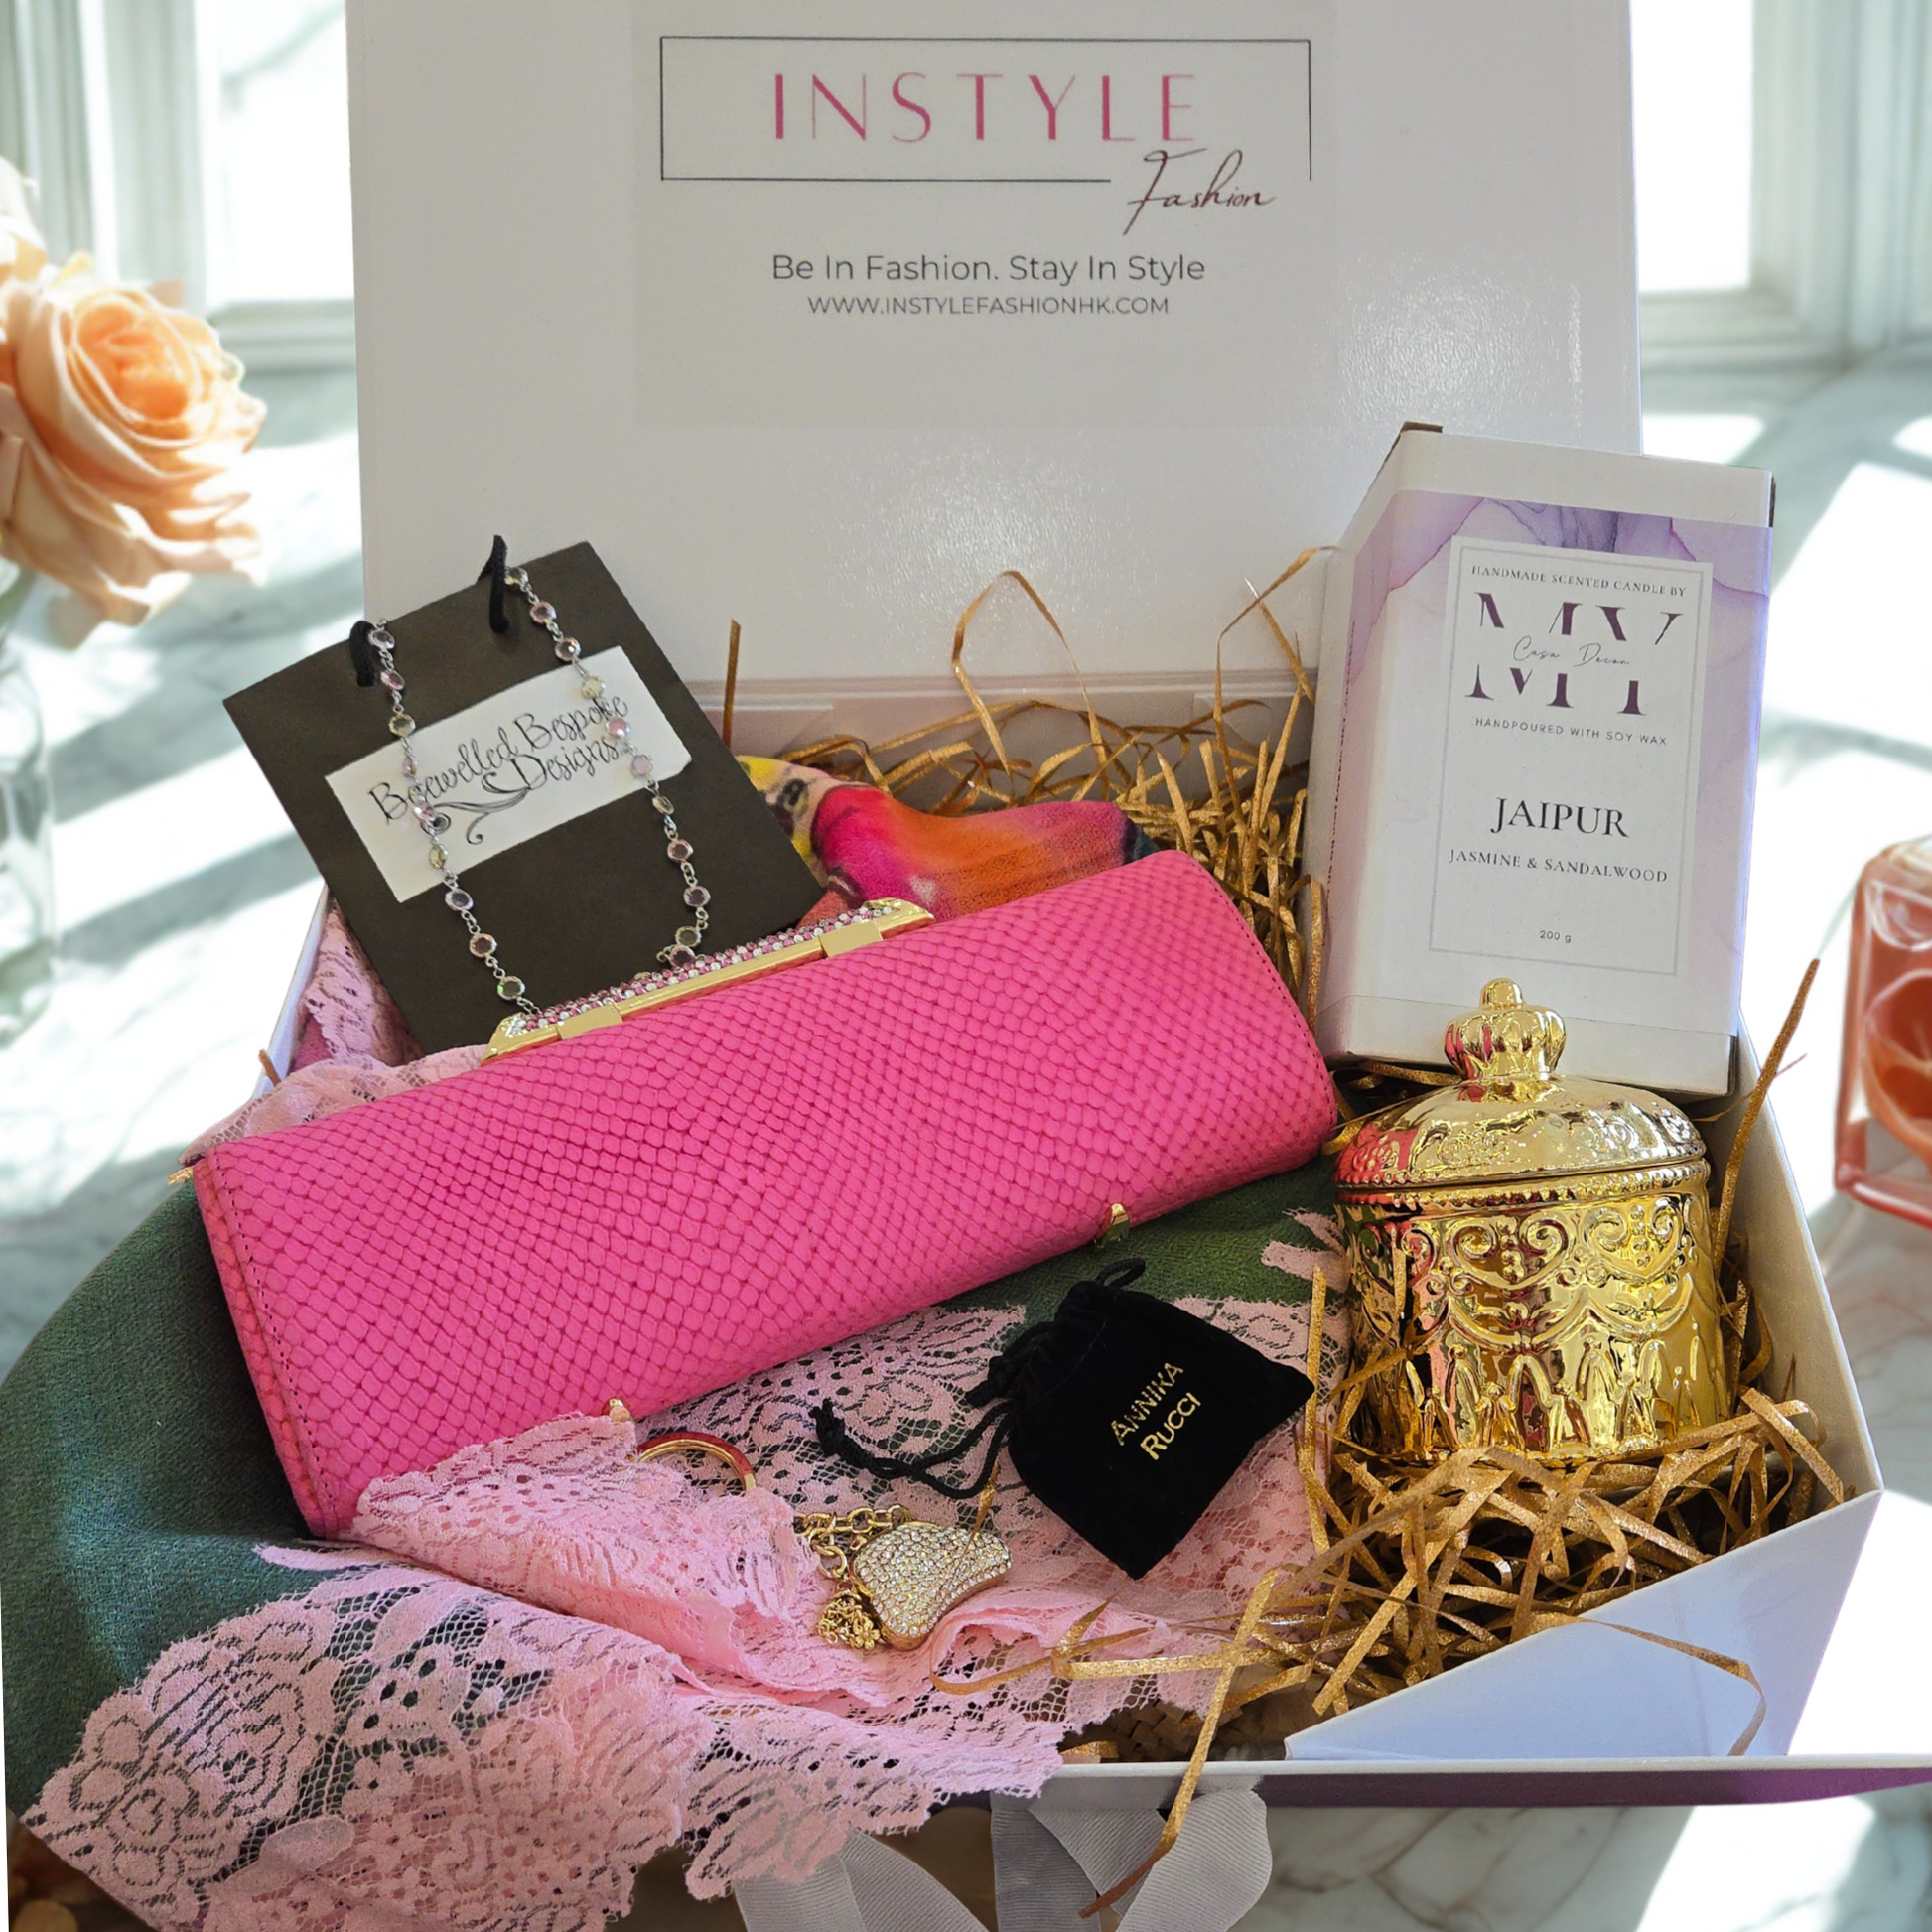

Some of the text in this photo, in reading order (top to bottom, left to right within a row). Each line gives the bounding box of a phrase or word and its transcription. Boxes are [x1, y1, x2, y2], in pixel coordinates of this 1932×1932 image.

[774, 71, 1196, 143] INSTYLE
[1123, 148, 1277, 237] Fashion
[772, 254, 1206, 287] Be In Fashion. Stay In Style
[807, 296, 1170, 316] WWW.INSTYLEFASHIONHK.COM
[1471, 565, 1687, 597] HANDMADE SCENTED CANDLE BY
[1512, 635, 1561, 662] Casa
[1475, 717, 1667, 747] HANDPOURED WITH SOY WAX
[484, 736, 620, 794] Designs
[1490, 796, 1630, 838] JAIPUR
[1449, 849, 1668, 883] JASMINE & SANDALWOOD
[1539, 929, 1572, 944] 200 g
[1110, 1362, 1185, 1447] ANNIKA
[1139, 1391, 1202, 1461] RUCCI
